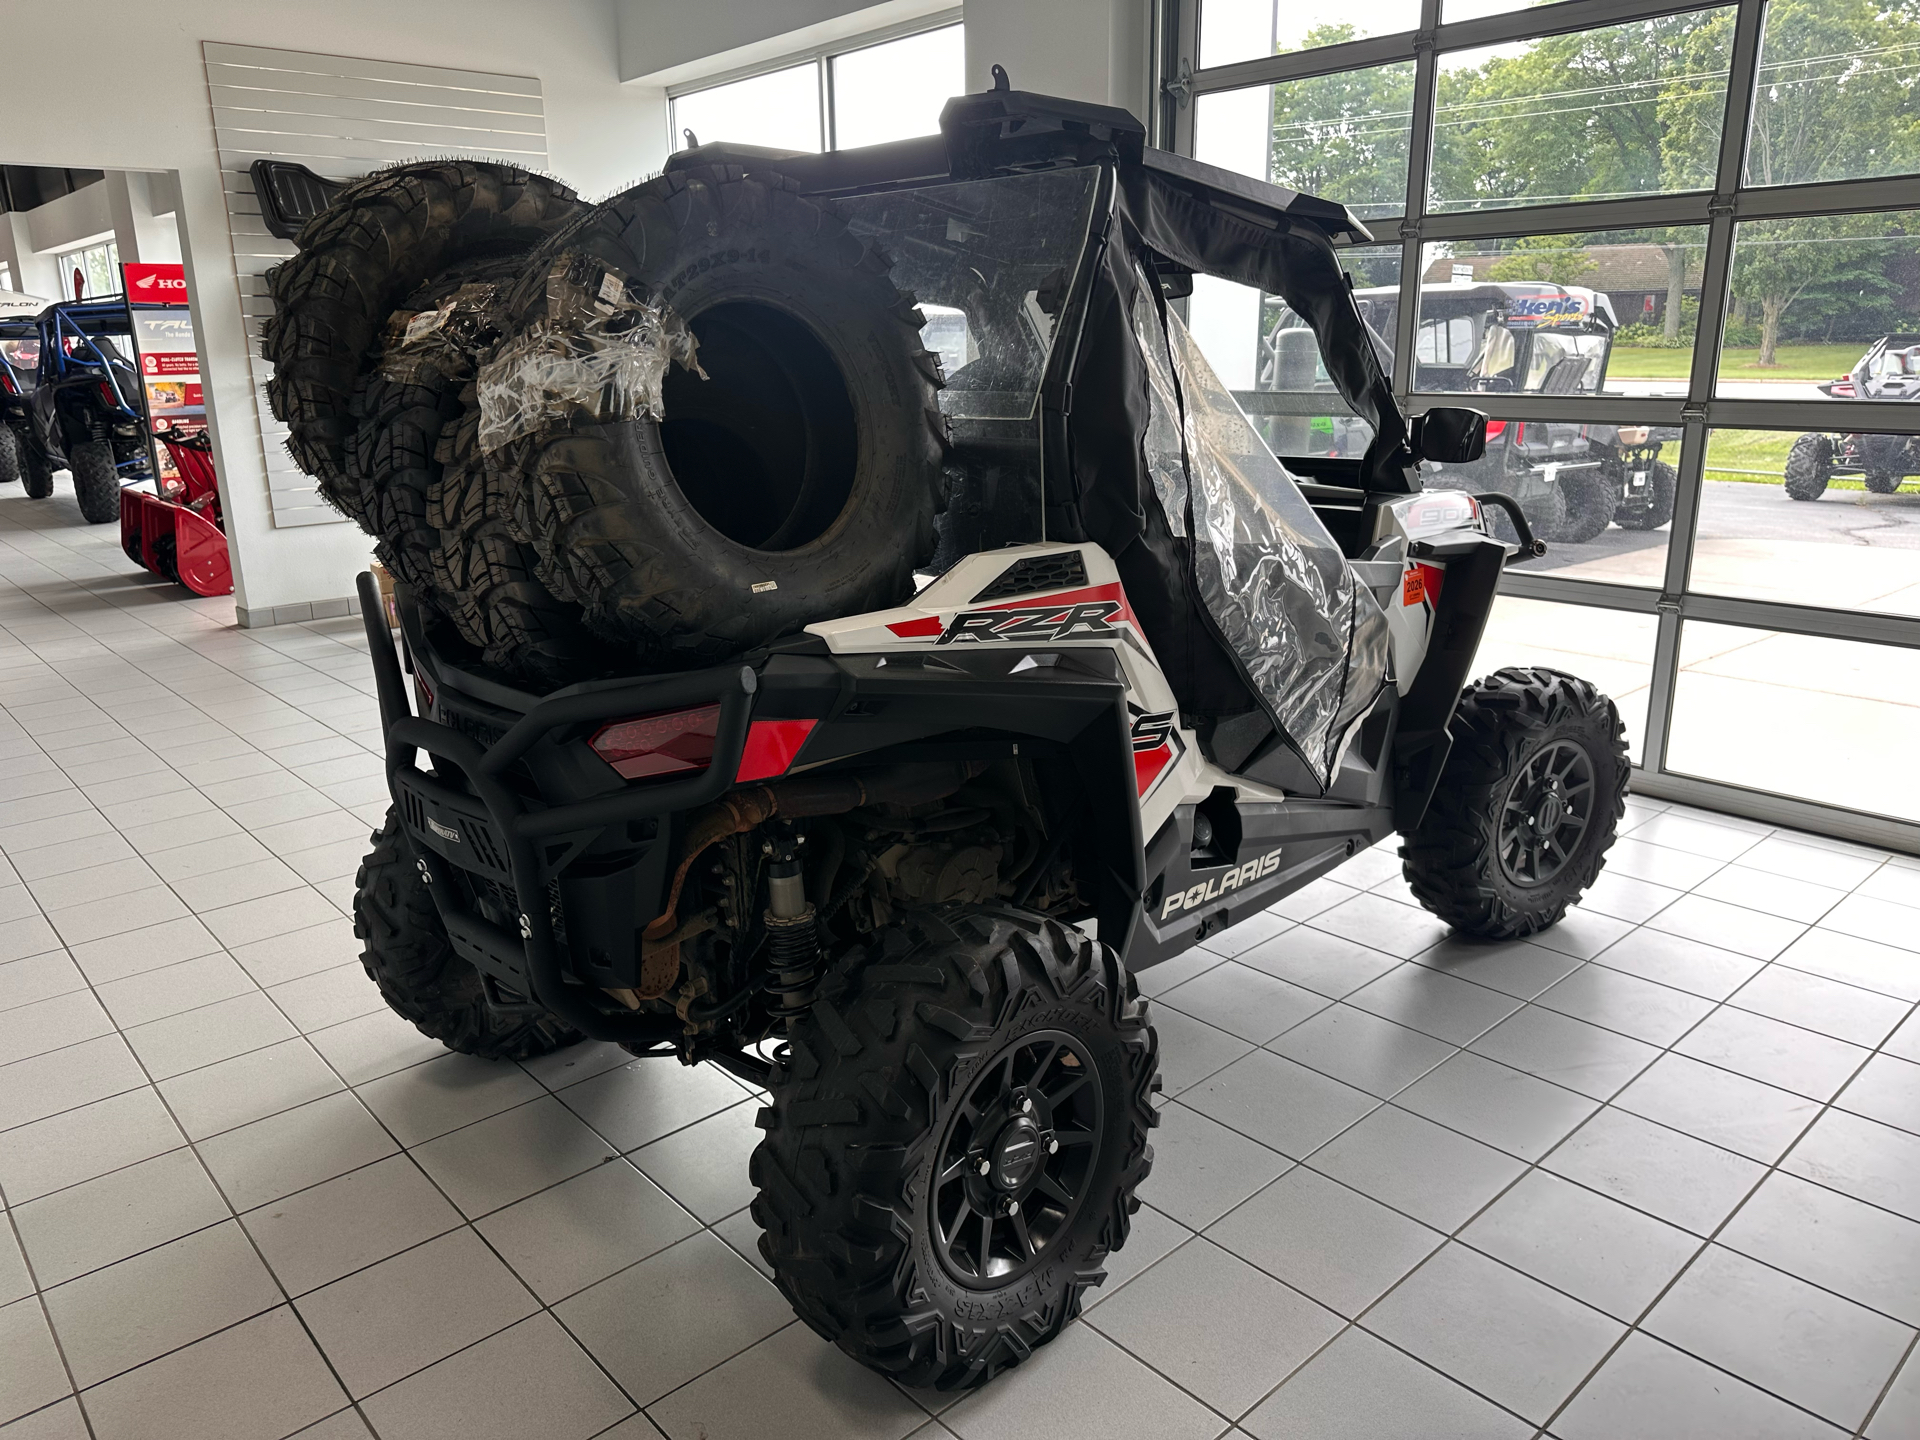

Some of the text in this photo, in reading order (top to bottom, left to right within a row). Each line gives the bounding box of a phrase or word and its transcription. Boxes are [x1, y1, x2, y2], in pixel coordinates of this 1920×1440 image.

[662, 246, 771, 303] AT29X9-14
[1406, 578, 1423, 593] 2026
[933, 601, 1123, 647] RZR
[1160, 847, 1283, 921] POLARIS
